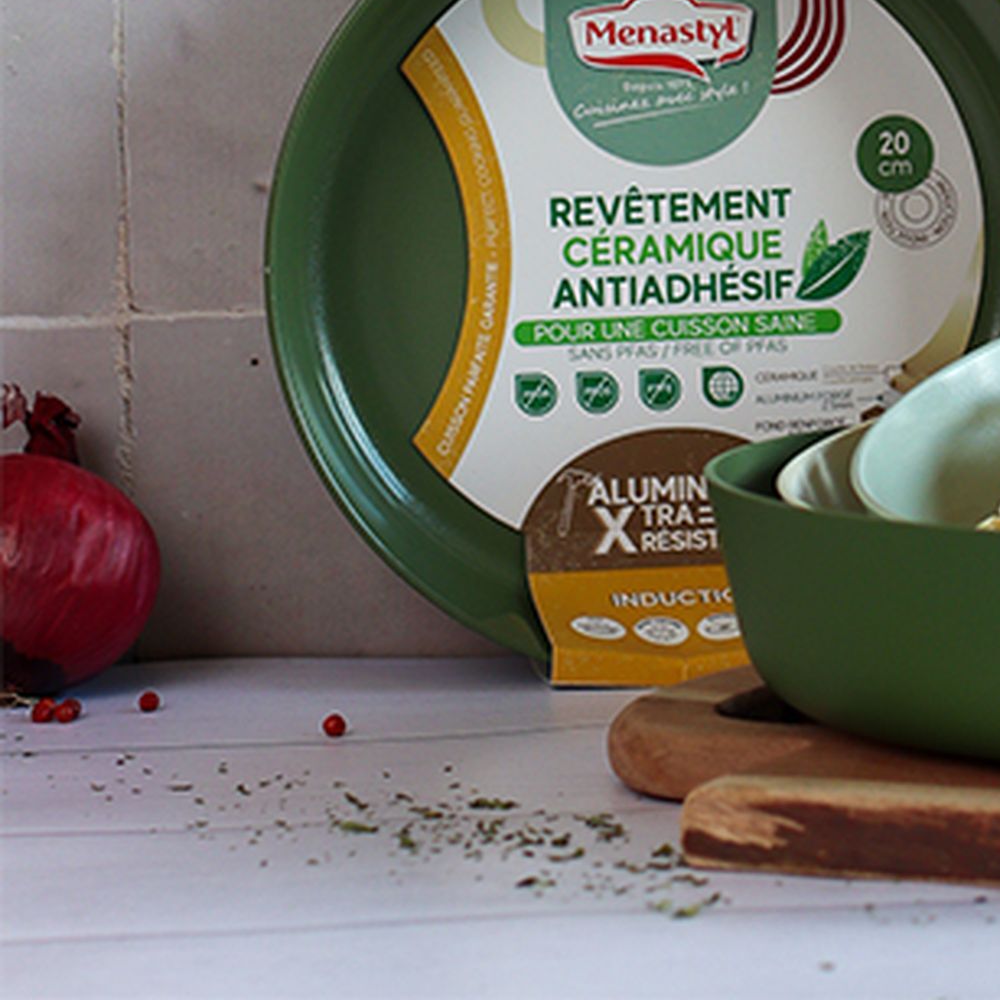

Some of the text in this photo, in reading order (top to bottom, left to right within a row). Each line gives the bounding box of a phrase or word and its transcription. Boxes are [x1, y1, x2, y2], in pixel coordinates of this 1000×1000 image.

[586, 16, 737, 49] Menastyl
[878, 130, 910, 155] 20
[878, 160, 912, 176] cm
[550, 186, 791, 227] REVÊTEMENT
[562, 228, 782, 267] CÉRAMIQUE
[553, 264, 794, 308] ANTIADHÉSIF
[533, 311, 816, 343] POUR UNE CUISSON SAINE
[568, 346, 612, 361] SANS
[616, 345, 658, 360] PFAS
[672, 341, 714, 356] FREE
[719, 340, 741, 355] OF
[745, 339, 788, 354] PFAS
